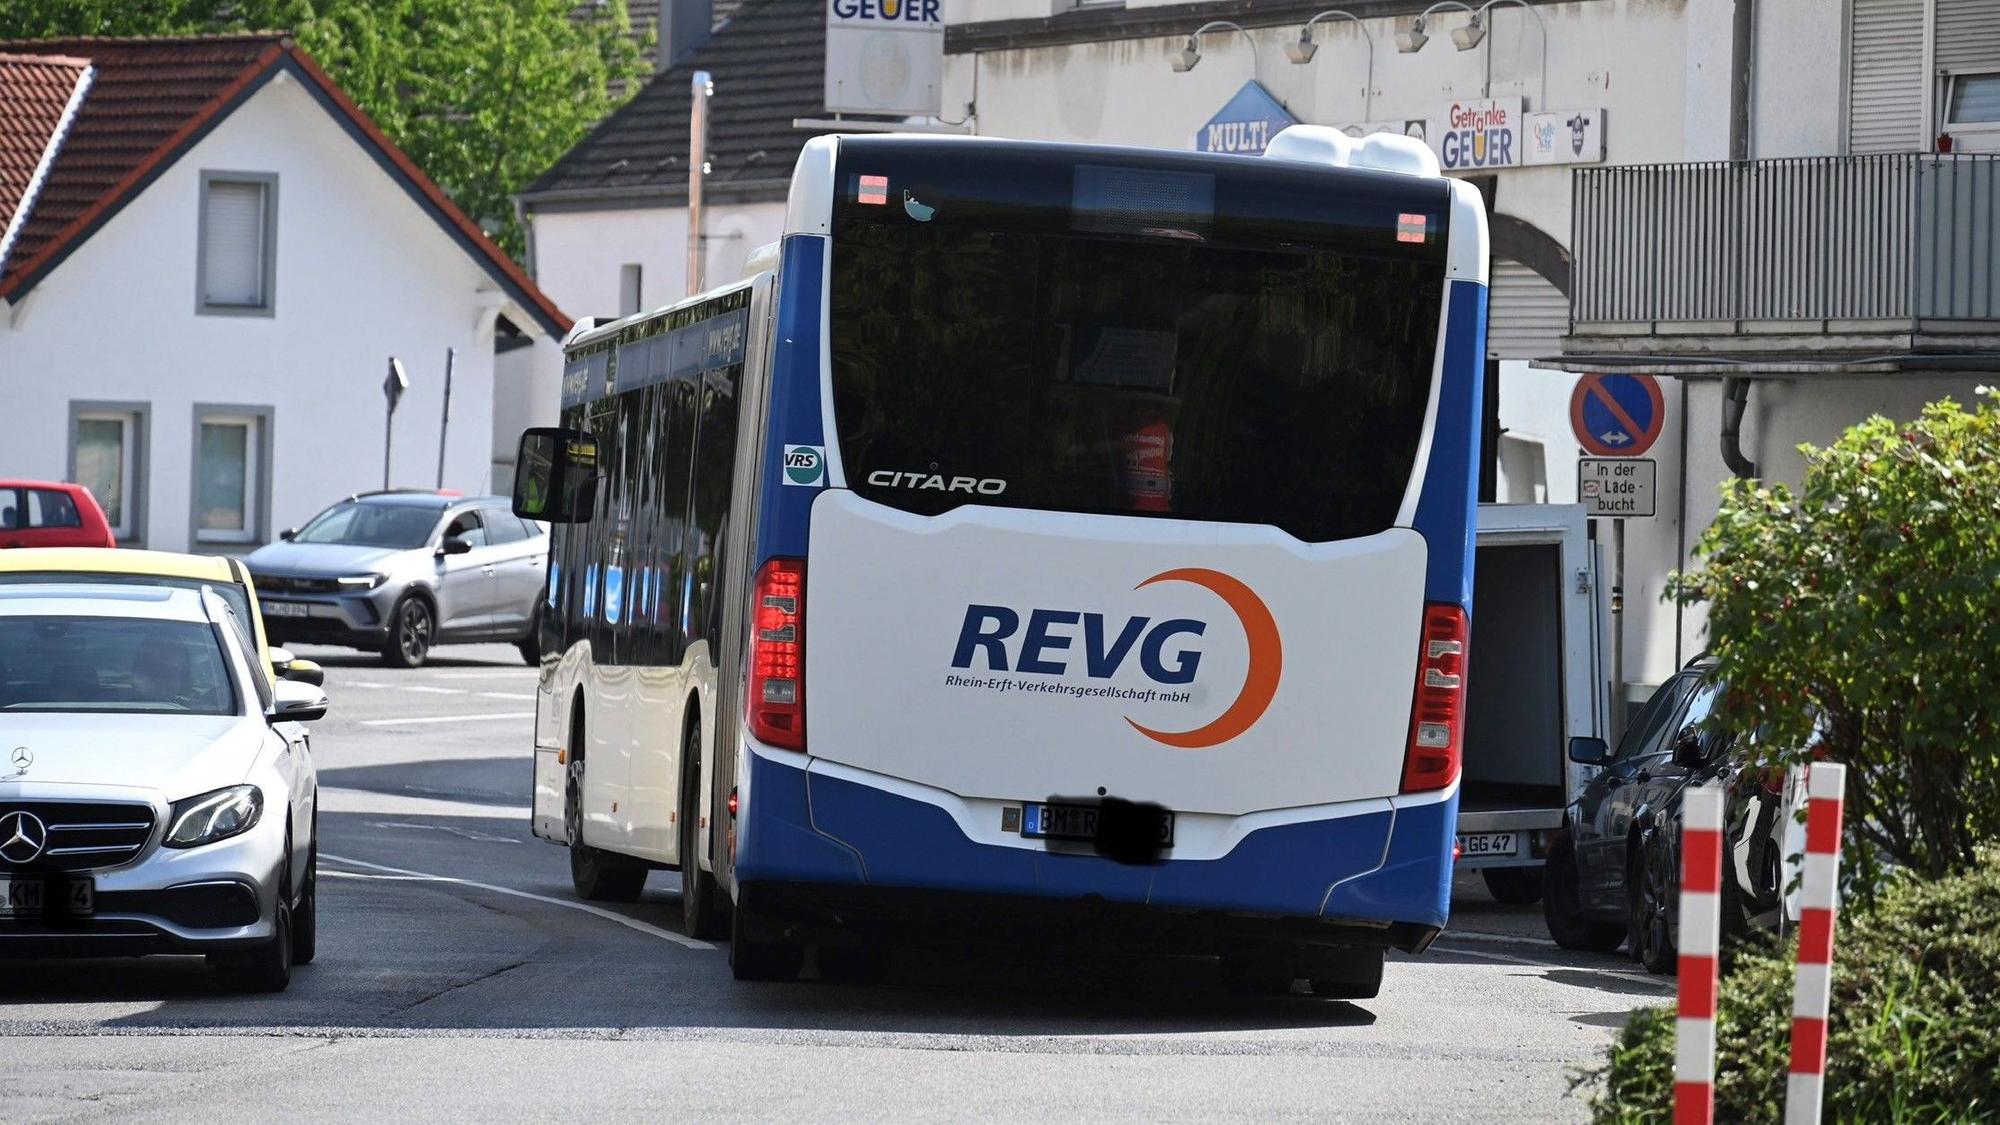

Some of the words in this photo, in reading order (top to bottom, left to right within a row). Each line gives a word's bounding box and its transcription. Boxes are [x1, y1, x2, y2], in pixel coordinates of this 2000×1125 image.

[833, 0, 940, 22] GEUER
[1450, 101, 1506, 132] Getränke
[1208, 121, 1268, 152] MULTI
[1443, 128, 1512, 168] GEUER
[785, 454, 814, 467] VRS
[1597, 463, 1608, 476] In
[1614, 463, 1636, 476] der
[868, 470, 1007, 495] CITARO
[1598, 497, 1635, 511] bucht
[951, 604, 1207, 684] REVG
[945, 675, 1156, 703] Rhein-Erft-Verkehrsgesellschaft
[1159, 692, 1190, 703] mbH
[1469, 836, 1488, 852] GG
[1492, 835, 1510, 851] 47
